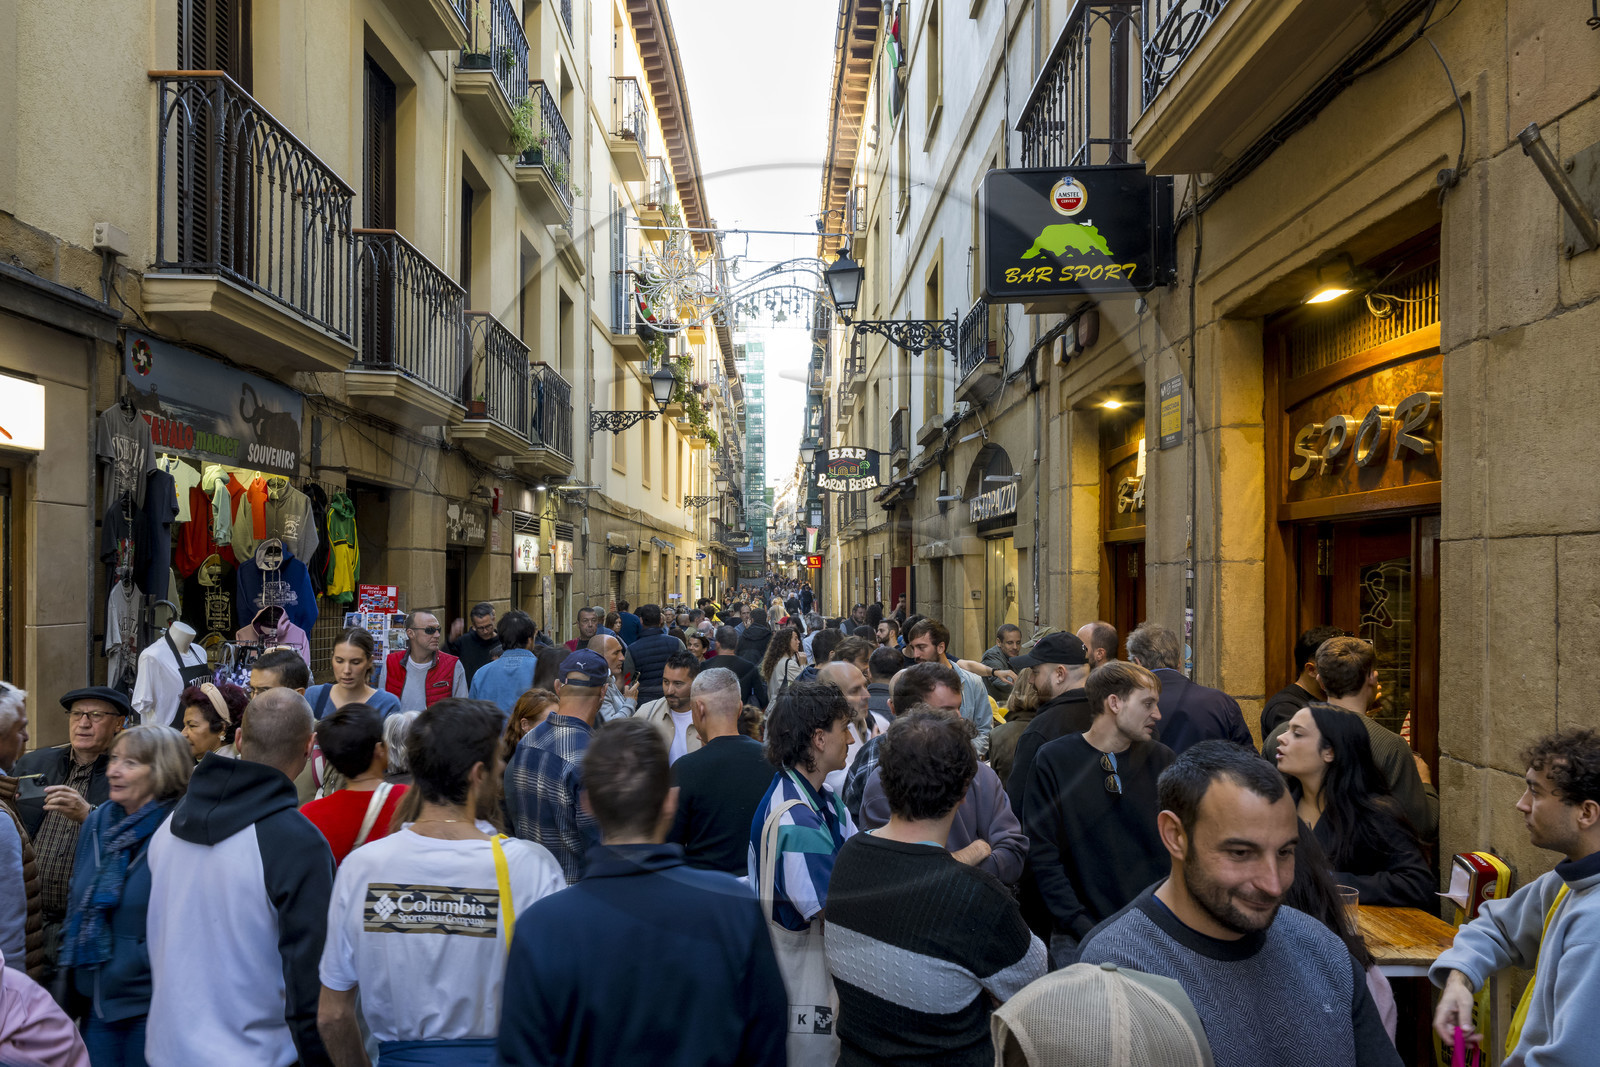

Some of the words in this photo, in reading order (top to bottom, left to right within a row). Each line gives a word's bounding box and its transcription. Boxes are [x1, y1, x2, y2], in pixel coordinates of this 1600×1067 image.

[1004, 266, 1054, 284] BAR
[1058, 262, 1137, 282] SPORT
[1289, 391, 1443, 482] SPOR
[247, 442, 296, 470] SOUVENIRS
[827, 447, 867, 460] BAR
[816, 473, 847, 491] BORDA
[397, 894, 487, 916] Columbia
[397, 912, 446, 924] Sportswear
[446, 913, 486, 928] Company
[797, 1013, 807, 1025] K
